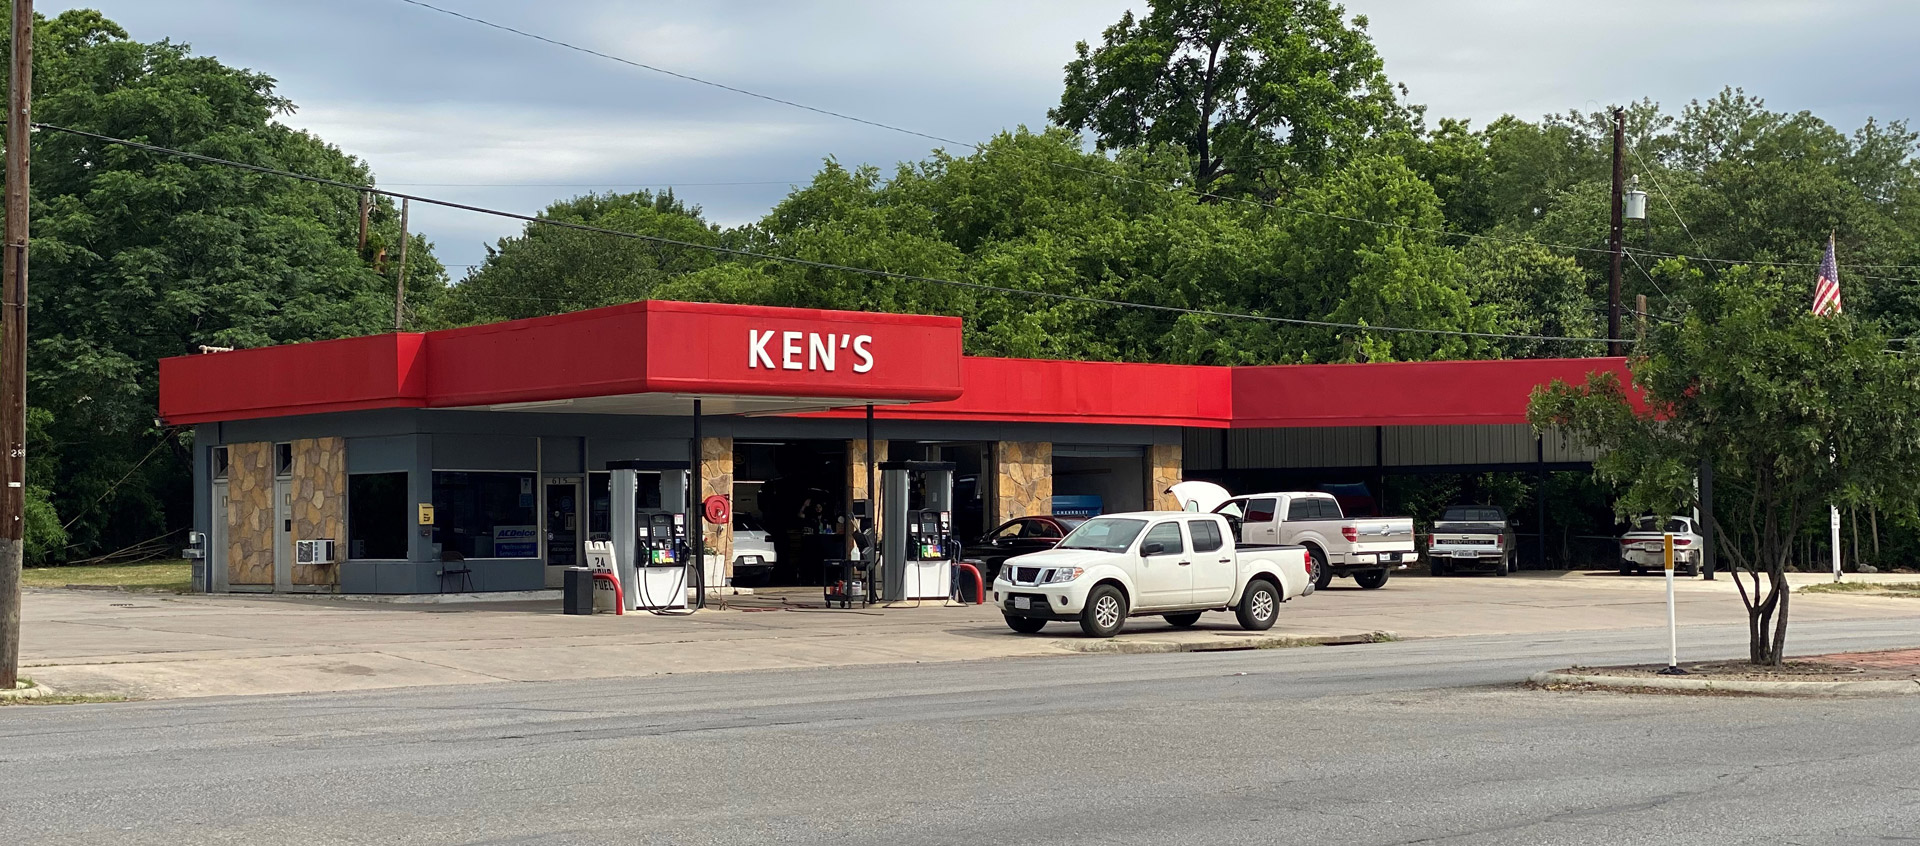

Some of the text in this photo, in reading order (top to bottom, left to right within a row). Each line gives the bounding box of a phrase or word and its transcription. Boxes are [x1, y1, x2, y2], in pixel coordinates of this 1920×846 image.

[748, 329, 874, 373] KEN'S
[552, 477, 568, 485] 615
[498, 529, 536, 537] ACDelco
[595, 557, 606, 568] 24
[594, 580, 614, 591] FUEL
